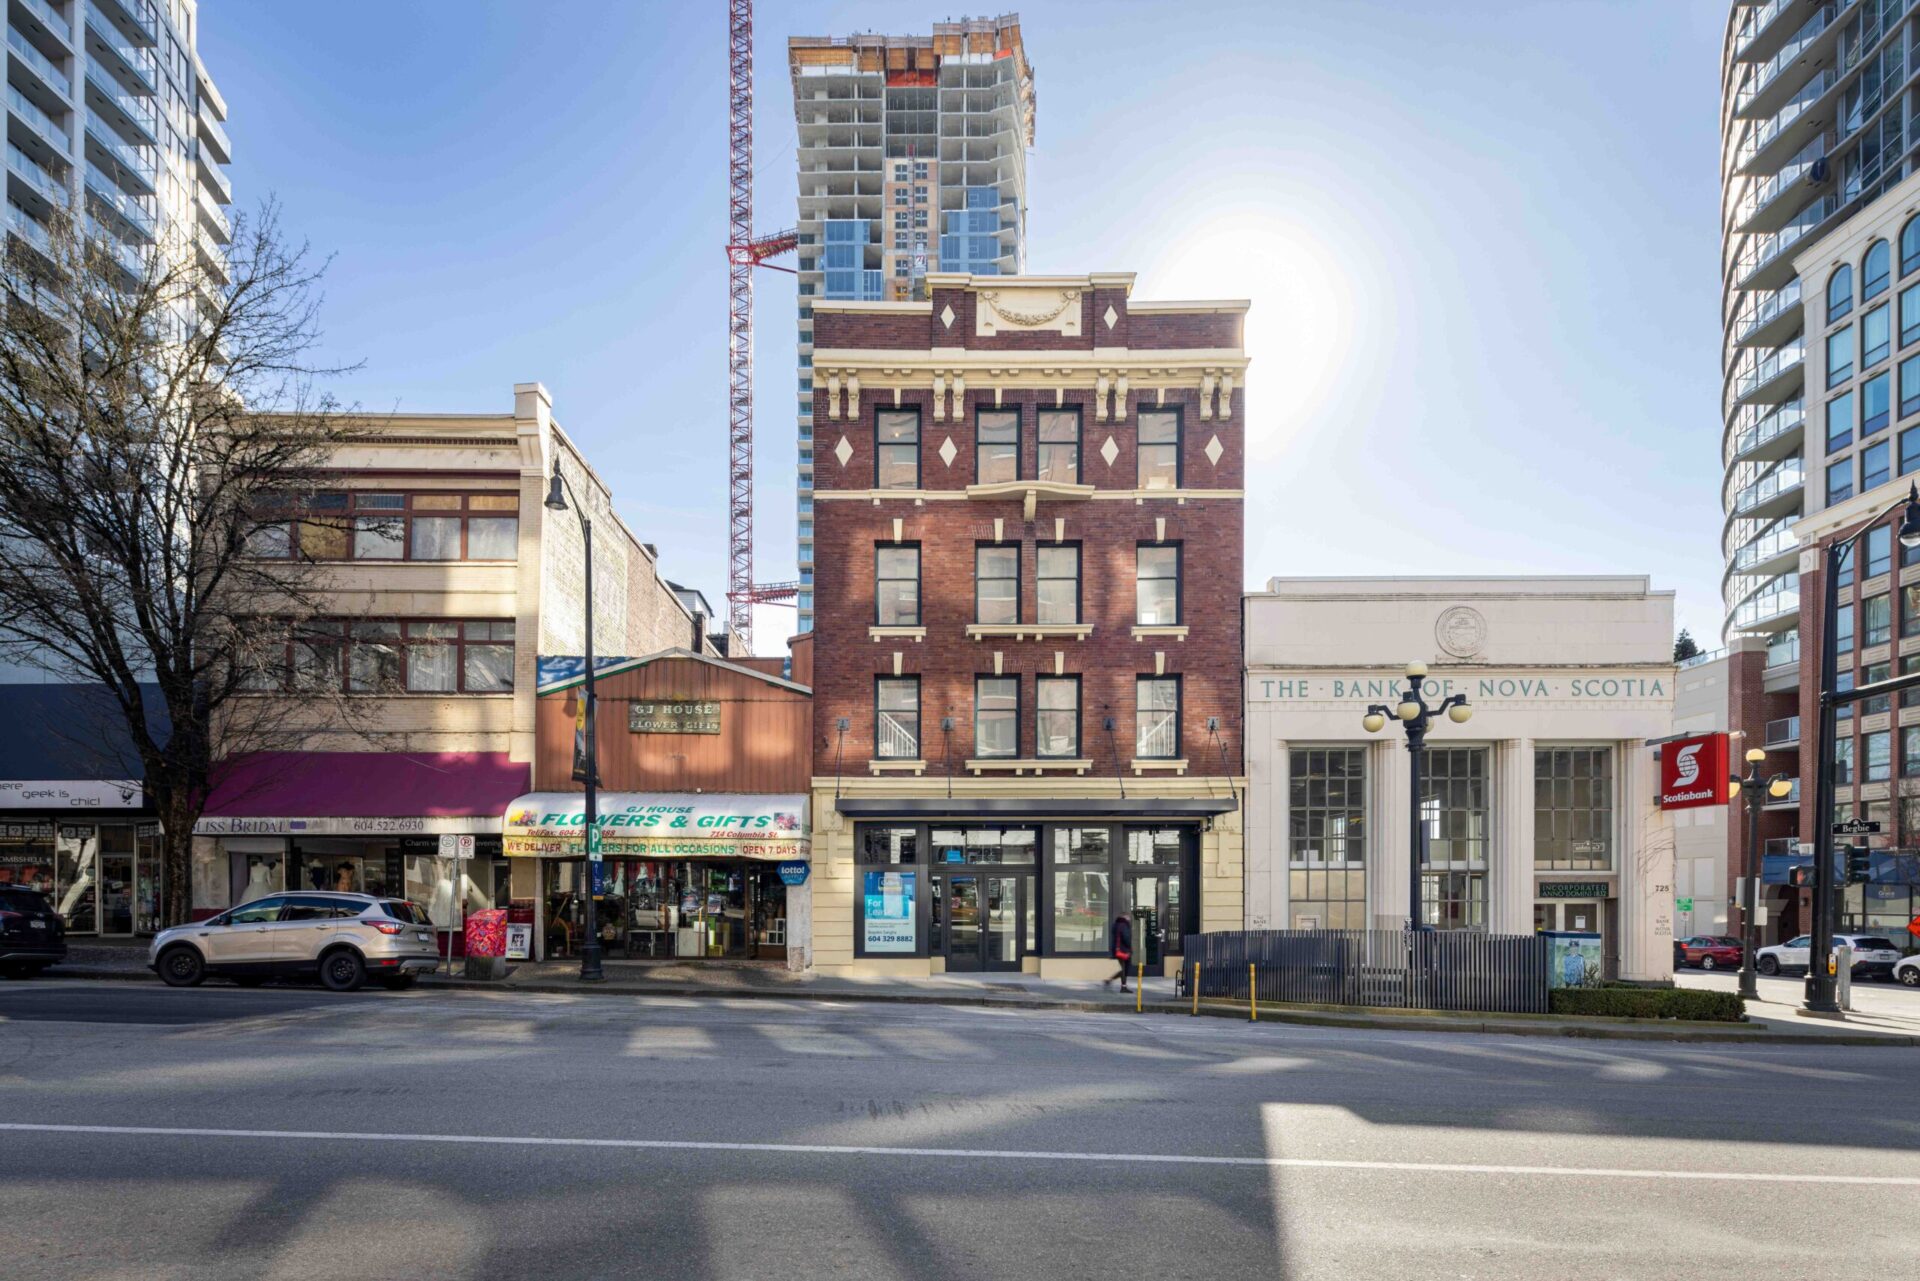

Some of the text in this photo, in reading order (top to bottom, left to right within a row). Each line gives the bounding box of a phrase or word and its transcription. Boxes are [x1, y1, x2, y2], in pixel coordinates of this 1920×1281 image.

[1260, 679, 1664, 698] THE BANK OF NOVA SCOTIA
[634, 704, 713, 714] GJ HOUSE
[630, 720, 678, 729] FLOWER
[0, 782, 23, 790] ere
[22, 789, 70, 799] geek is
[1663, 789, 1713, 804] Scotiabank
[70, 797, 100, 806] chic!
[353, 820, 424, 831] 604.522.6930
[540, 813, 771, 828] FLOWERS & GIFTS
[1842, 823, 1870, 834] Begbie
[592, 828, 600, 849] P
[727, 831, 765, 839] Columbia
[405, 839, 429, 847] Charm
[507, 843, 521, 851] WE
[524, 843, 561, 854] DELIVER
[569, 843, 736, 855] FLERS FOR ALL OCCASIONS
[742, 845, 766, 855] OPEN
[768, 846, 773, 854] 7
[776, 845, 797, 855] DAYS
[781, 866, 805, 874] lotto!
[1542, 884, 1607, 892] INCORPORATED
[867, 898, 882, 907] For
[867, 908, 892, 916] Lea
[867, 935, 913, 943] 604 329 8882
